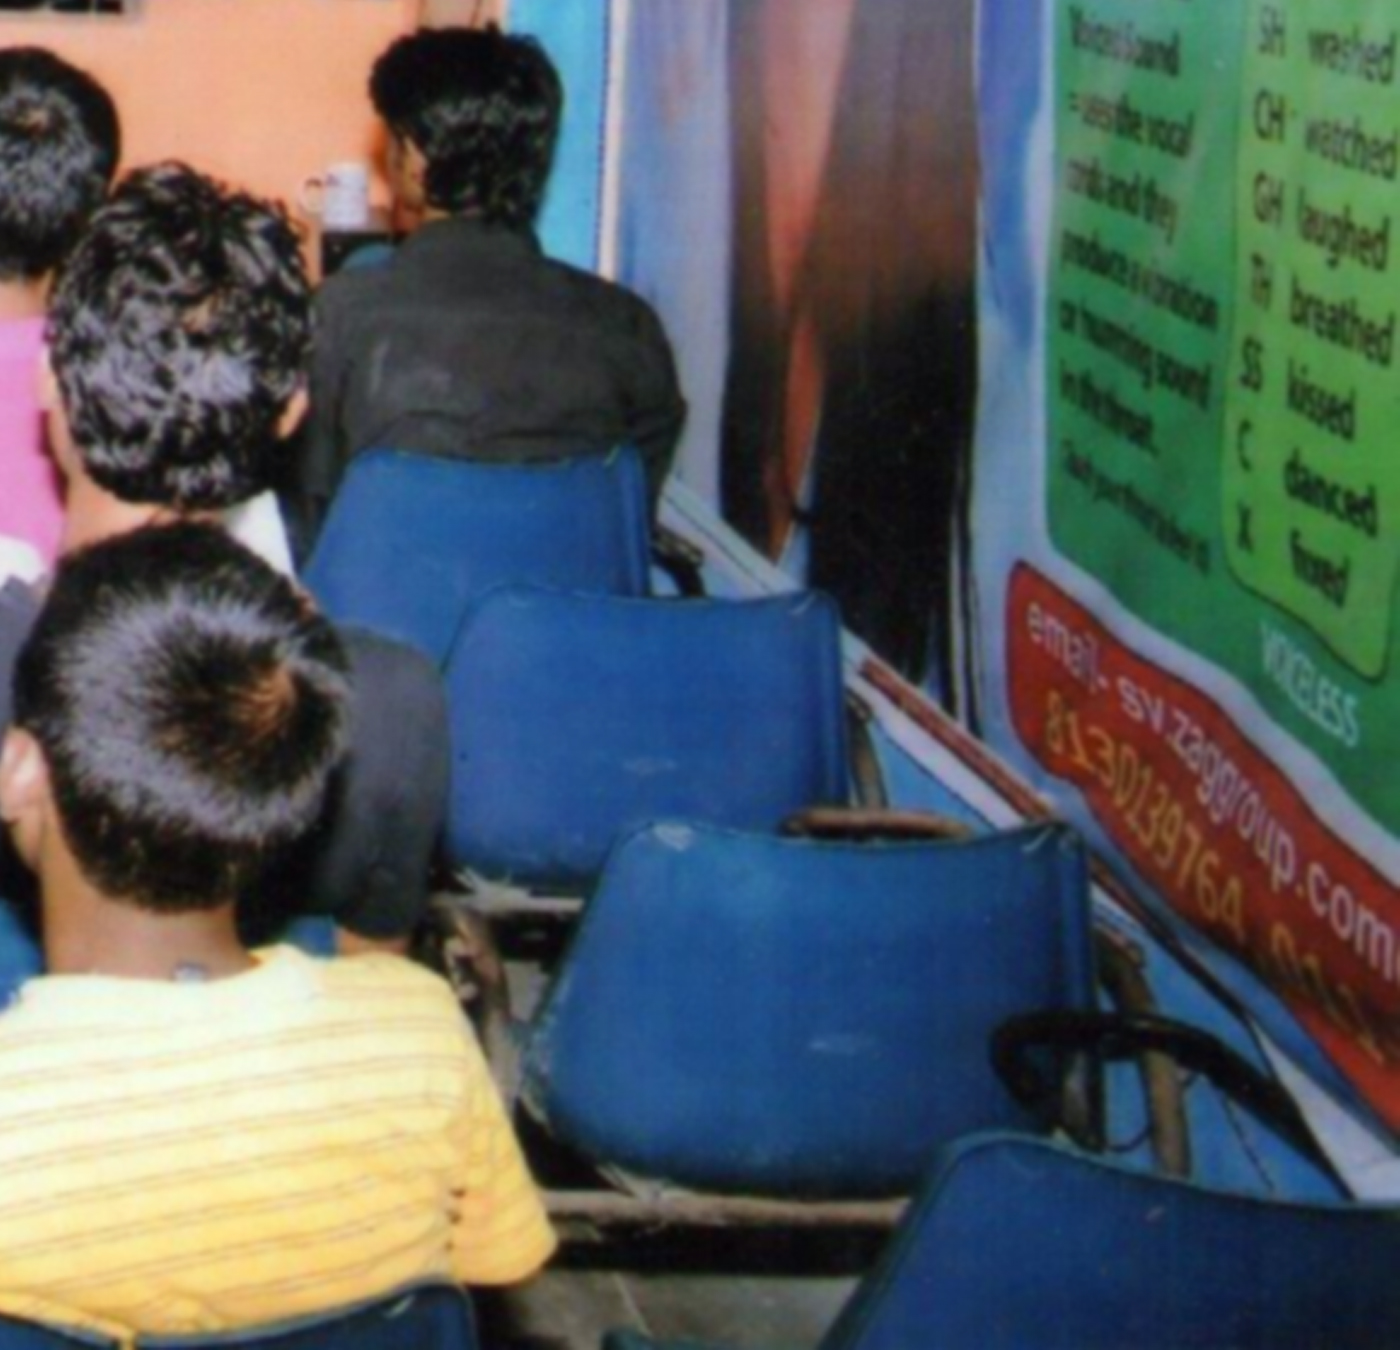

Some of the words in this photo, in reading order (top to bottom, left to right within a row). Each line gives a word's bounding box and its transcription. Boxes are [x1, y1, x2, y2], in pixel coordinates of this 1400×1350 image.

[1307, 24, 1398, 87] washed
[1304, 114, 1400, 182] watched
[1297, 185, 1391, 273] laughed
[1289, 270, 1397, 370] breathed
[1260, 617, 1360, 749] VOICELESS
